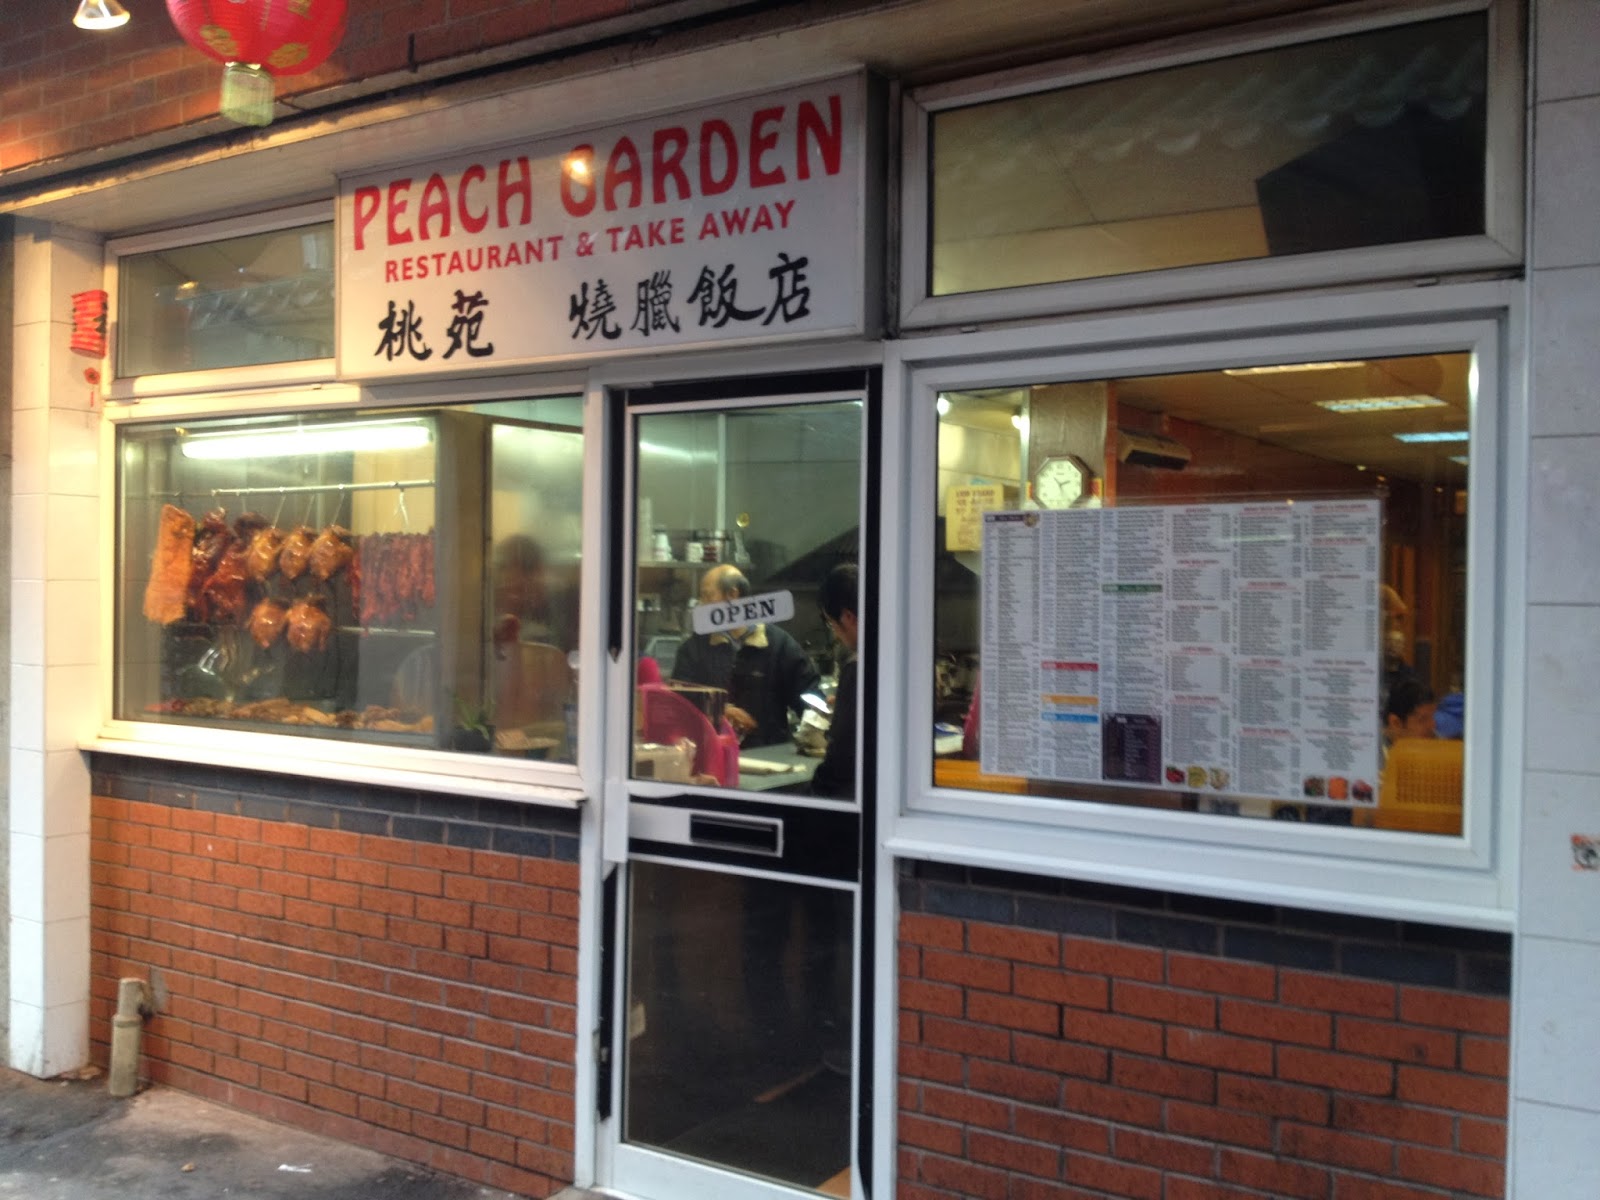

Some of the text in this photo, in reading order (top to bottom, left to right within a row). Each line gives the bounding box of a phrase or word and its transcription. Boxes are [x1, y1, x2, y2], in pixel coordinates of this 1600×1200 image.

[353, 94, 842, 251] PEACH GARDEN
[384, 199, 796, 283] RESTAURANT & TAKE AWAY
[374, 288, 495, 362] 桃苑
[709, 598, 776, 626] OPEN
